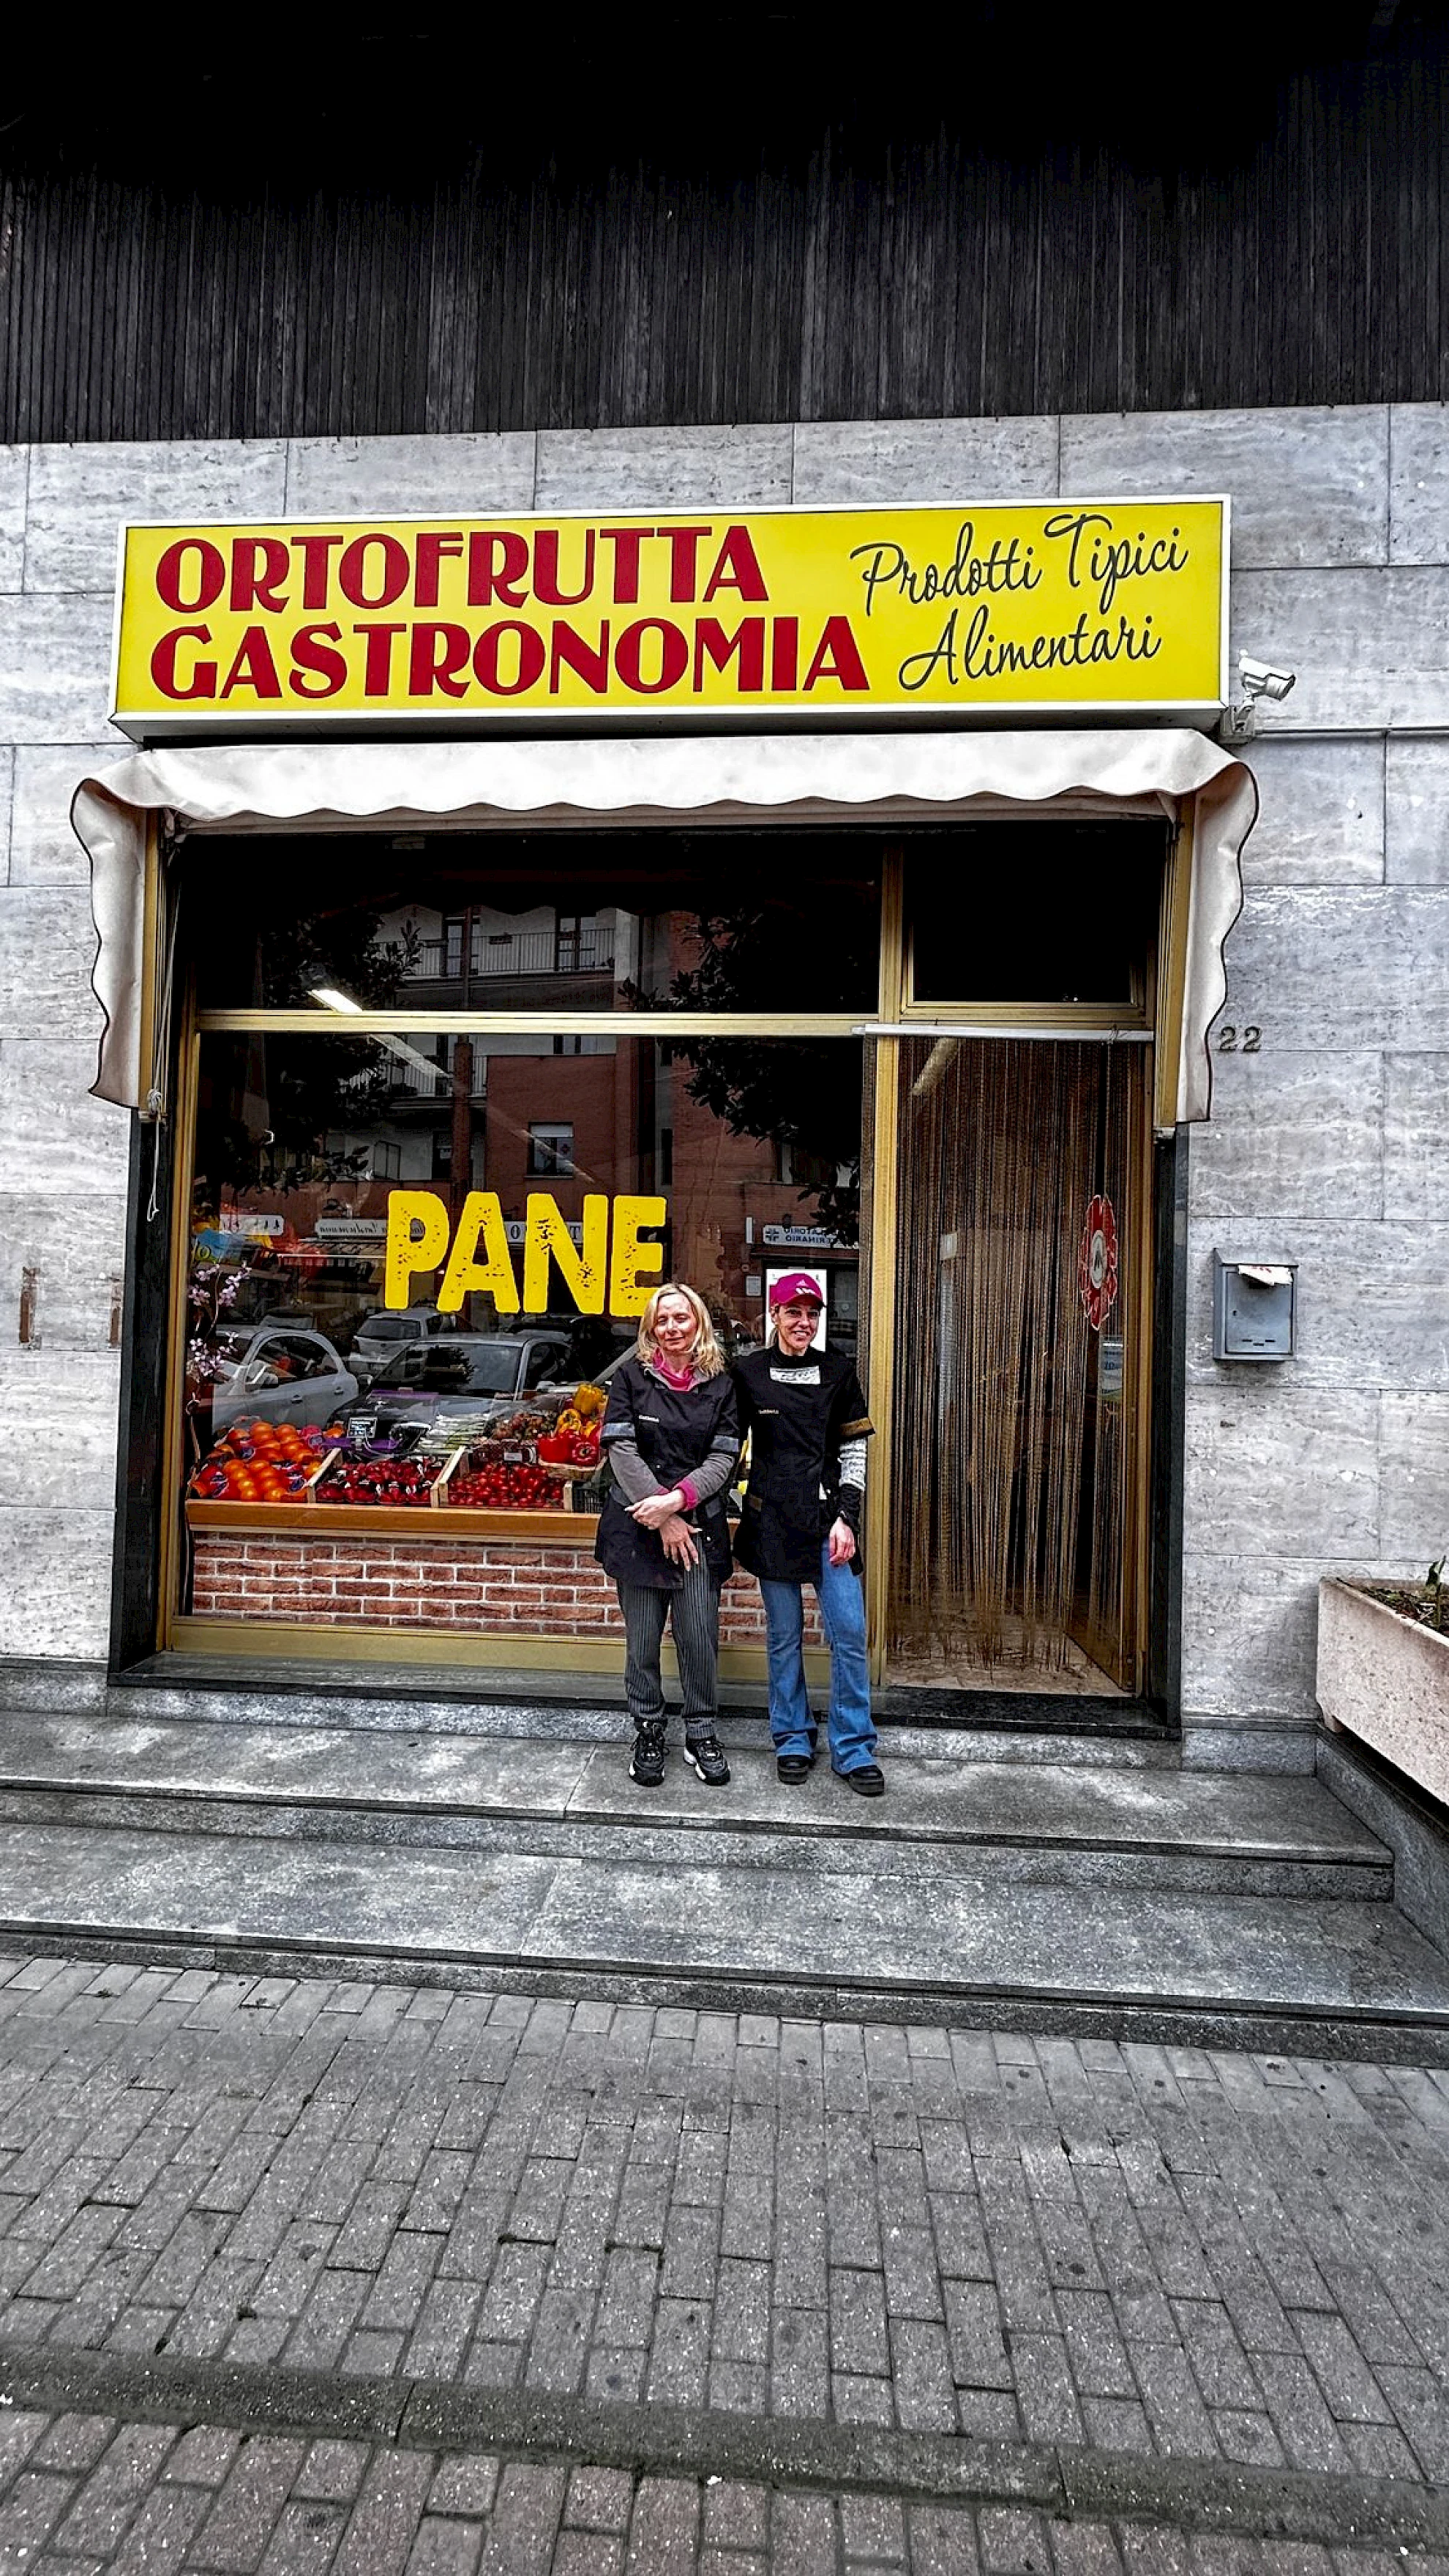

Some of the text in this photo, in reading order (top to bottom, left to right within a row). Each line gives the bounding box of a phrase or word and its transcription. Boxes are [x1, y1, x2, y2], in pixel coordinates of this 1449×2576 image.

[156, 526, 768, 613] ORTOFRUTTA
[850, 514, 1189, 616] Prodotti Tipici
[151, 616, 869, 699] GASTRONOMIA
[899, 605, 1161, 690] Alimentari
[1220, 1026, 1261, 1052] 22
[385, 1190, 667, 1317] PANE
